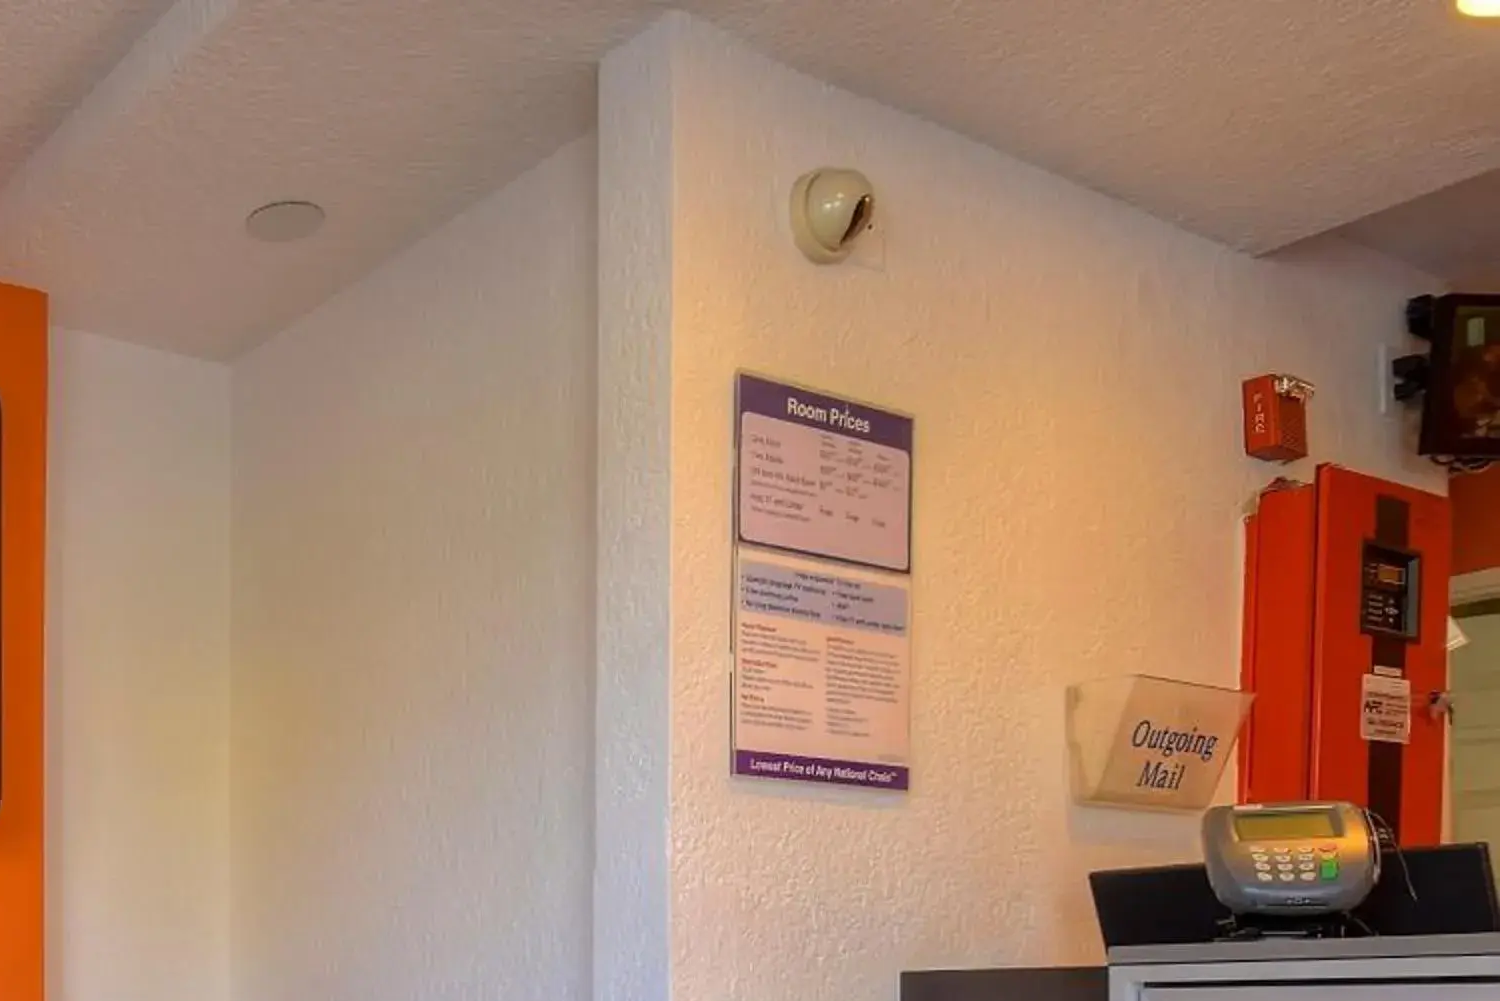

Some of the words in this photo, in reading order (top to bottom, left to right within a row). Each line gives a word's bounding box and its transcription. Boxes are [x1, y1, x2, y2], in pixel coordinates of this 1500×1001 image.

[787, 396, 827, 422] Room
[830, 405, 871, 433] Prices
[1132, 720, 1219, 761] Outgoing
[783, 760, 804, 774] Price
[1136, 760, 1185, 790] Mail
